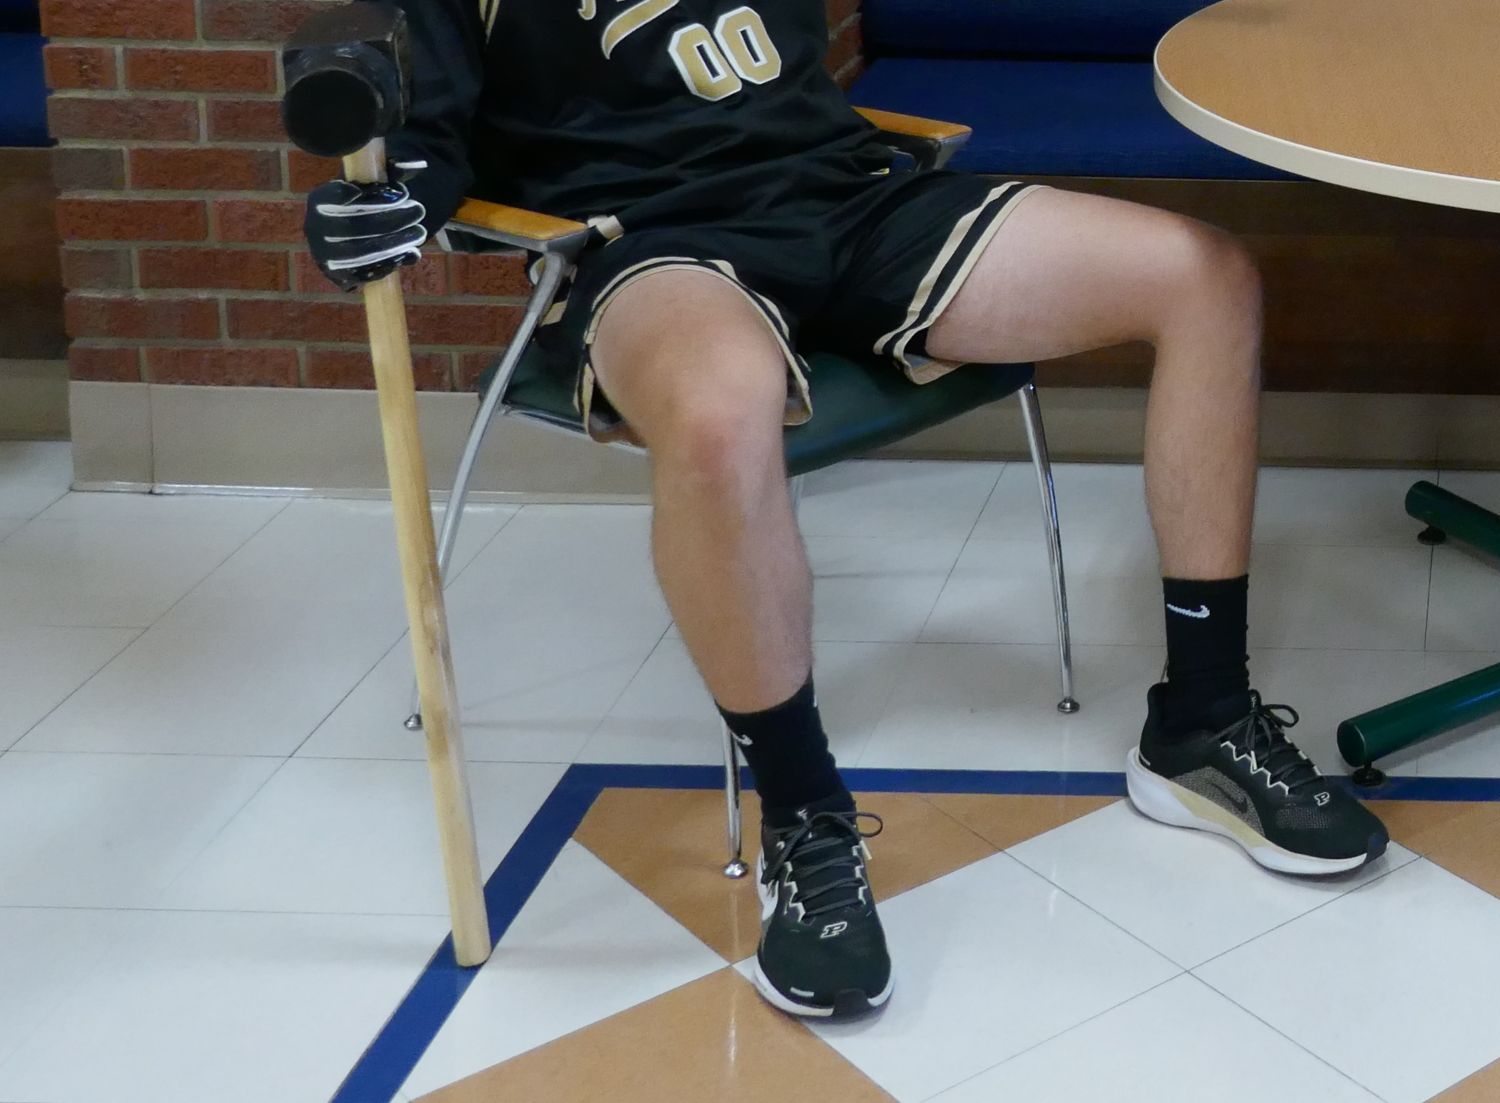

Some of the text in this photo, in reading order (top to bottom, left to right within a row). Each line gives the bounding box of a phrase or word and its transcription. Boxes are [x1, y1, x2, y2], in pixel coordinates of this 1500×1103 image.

[667, 5, 783, 102] 00
[1313, 791, 1331, 807] P
[820, 920, 849, 939] P
